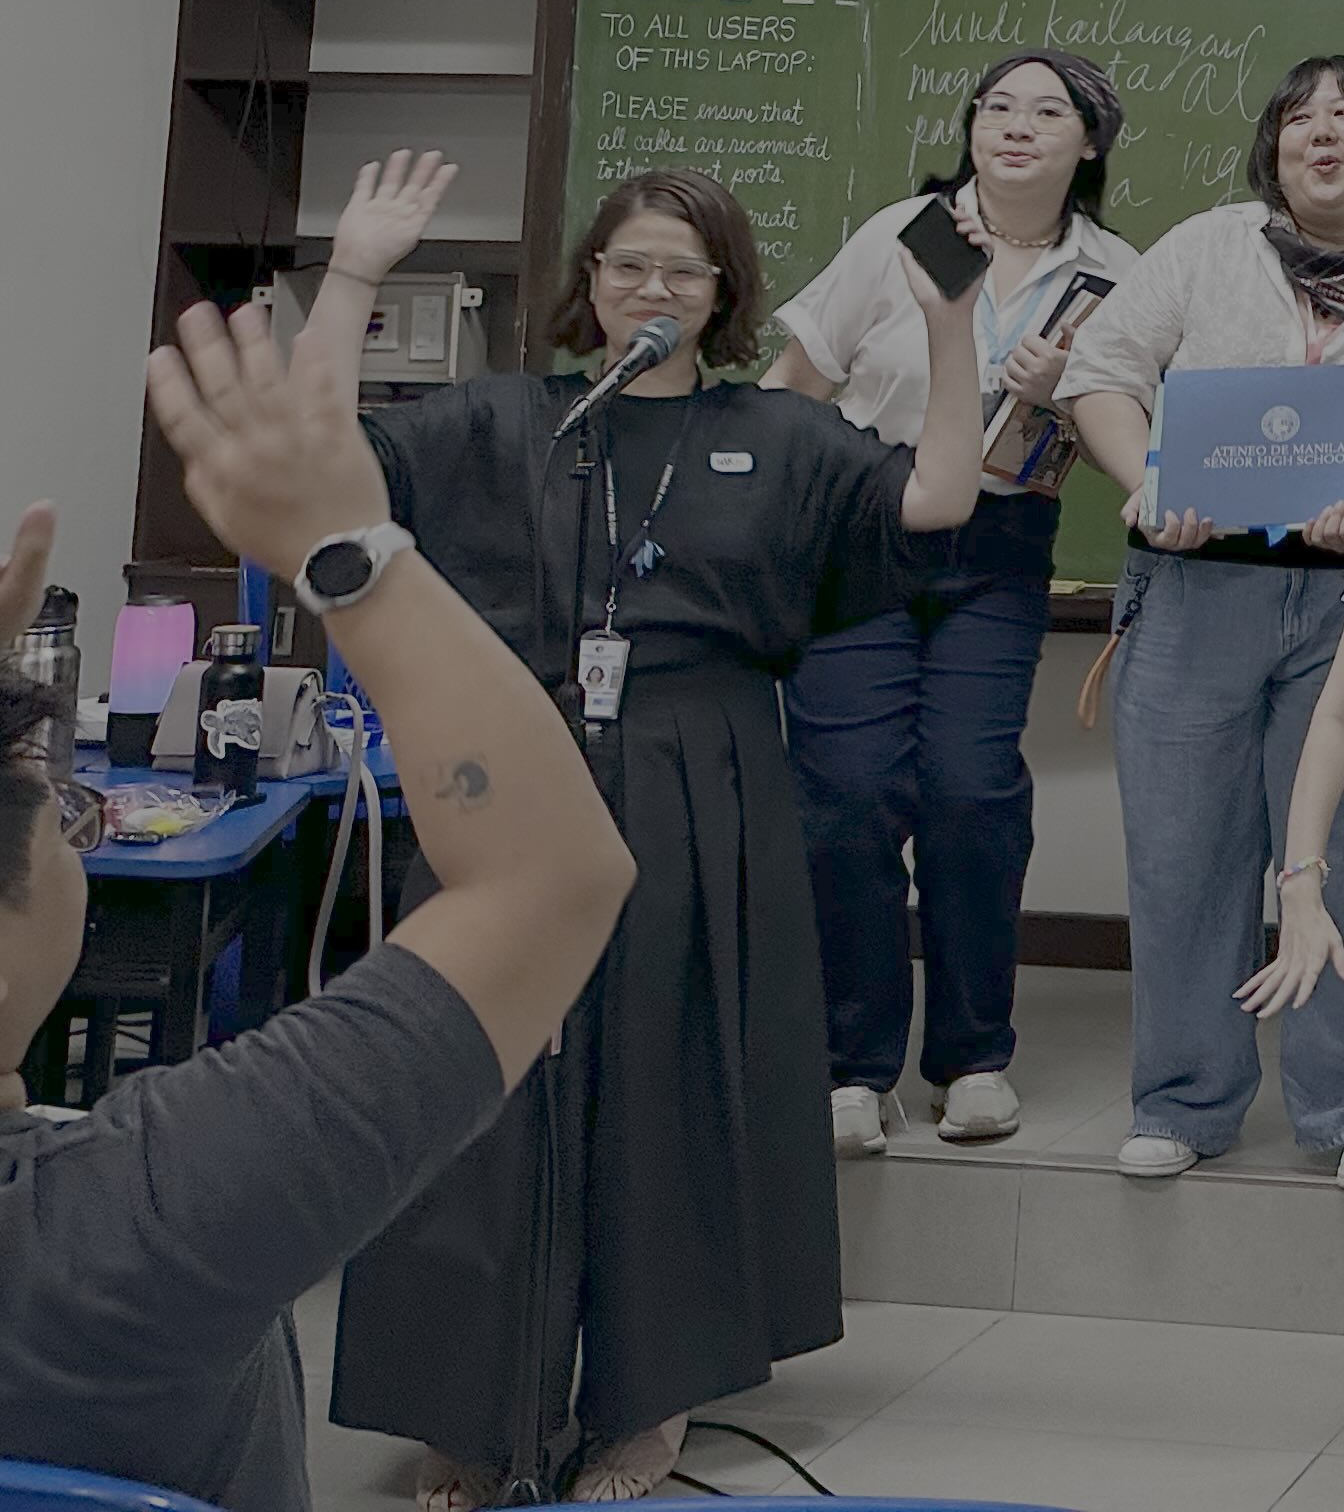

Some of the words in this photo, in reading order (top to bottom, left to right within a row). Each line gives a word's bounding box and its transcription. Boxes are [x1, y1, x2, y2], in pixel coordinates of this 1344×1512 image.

[601, 12, 634, 38] TO
[644, 14, 689, 38] ALL
[708, 16, 796, 42] USERS
[616, 45, 653, 71] OF
[660, 47, 710, 70] THIS
[718, 49, 815, 74] LAPTOP:
[602, 91, 689, 121] PLEASE
[695, 103, 759, 124] ensure
[761, 98, 804, 126] that
[597, 127, 627, 151] all
[634, 128, 688, 154] cables
[695, 137, 725, 154] are
[597, 157, 615, 180] to
[1203, 455, 1253, 469] SENIOR
[1257, 455, 1293, 467] HIGH
[1211, 445, 1267, 457] ATENEO
[1271, 444, 1290, 456] DE
